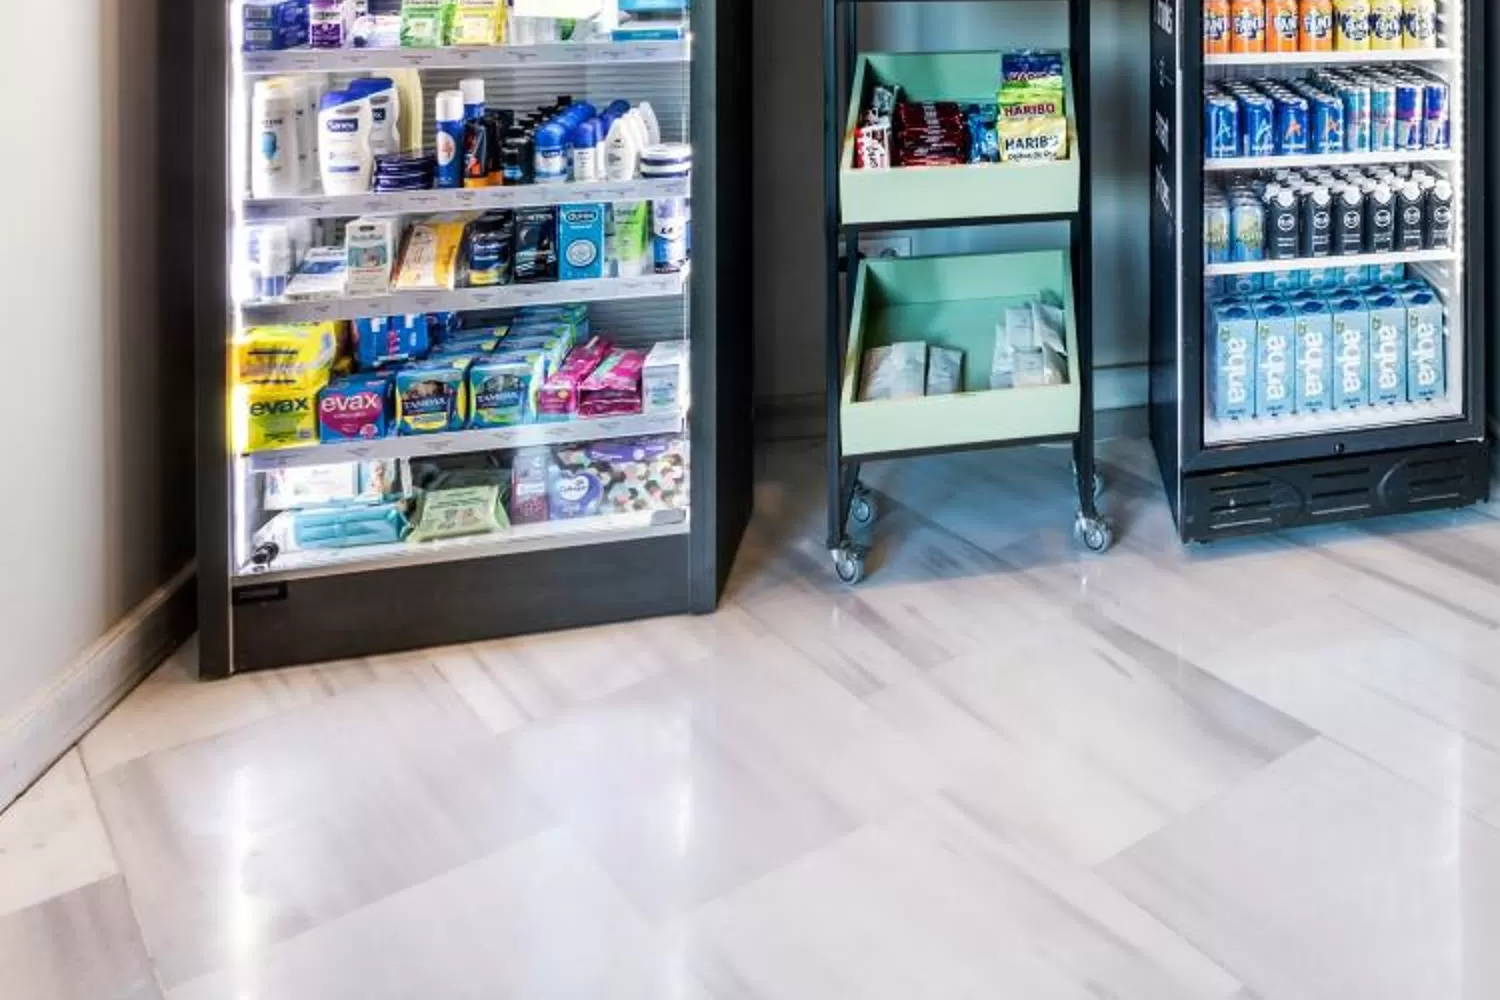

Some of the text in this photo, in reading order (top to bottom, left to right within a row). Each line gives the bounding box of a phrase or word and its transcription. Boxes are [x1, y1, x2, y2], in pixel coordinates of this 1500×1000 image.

[1004, 103, 1055, 117] HARIBO
[1220, 338, 1247, 403] aqua
[1259, 335, 1286, 400] aqua
[1297, 331, 1323, 397] aqua
[1336, 329, 1361, 393] aqua
[1373, 325, 1398, 389] aqua
[1411, 322, 1435, 386] aqua
[250, 396, 310, 416] evax
[321, 392, 379, 413] evax
